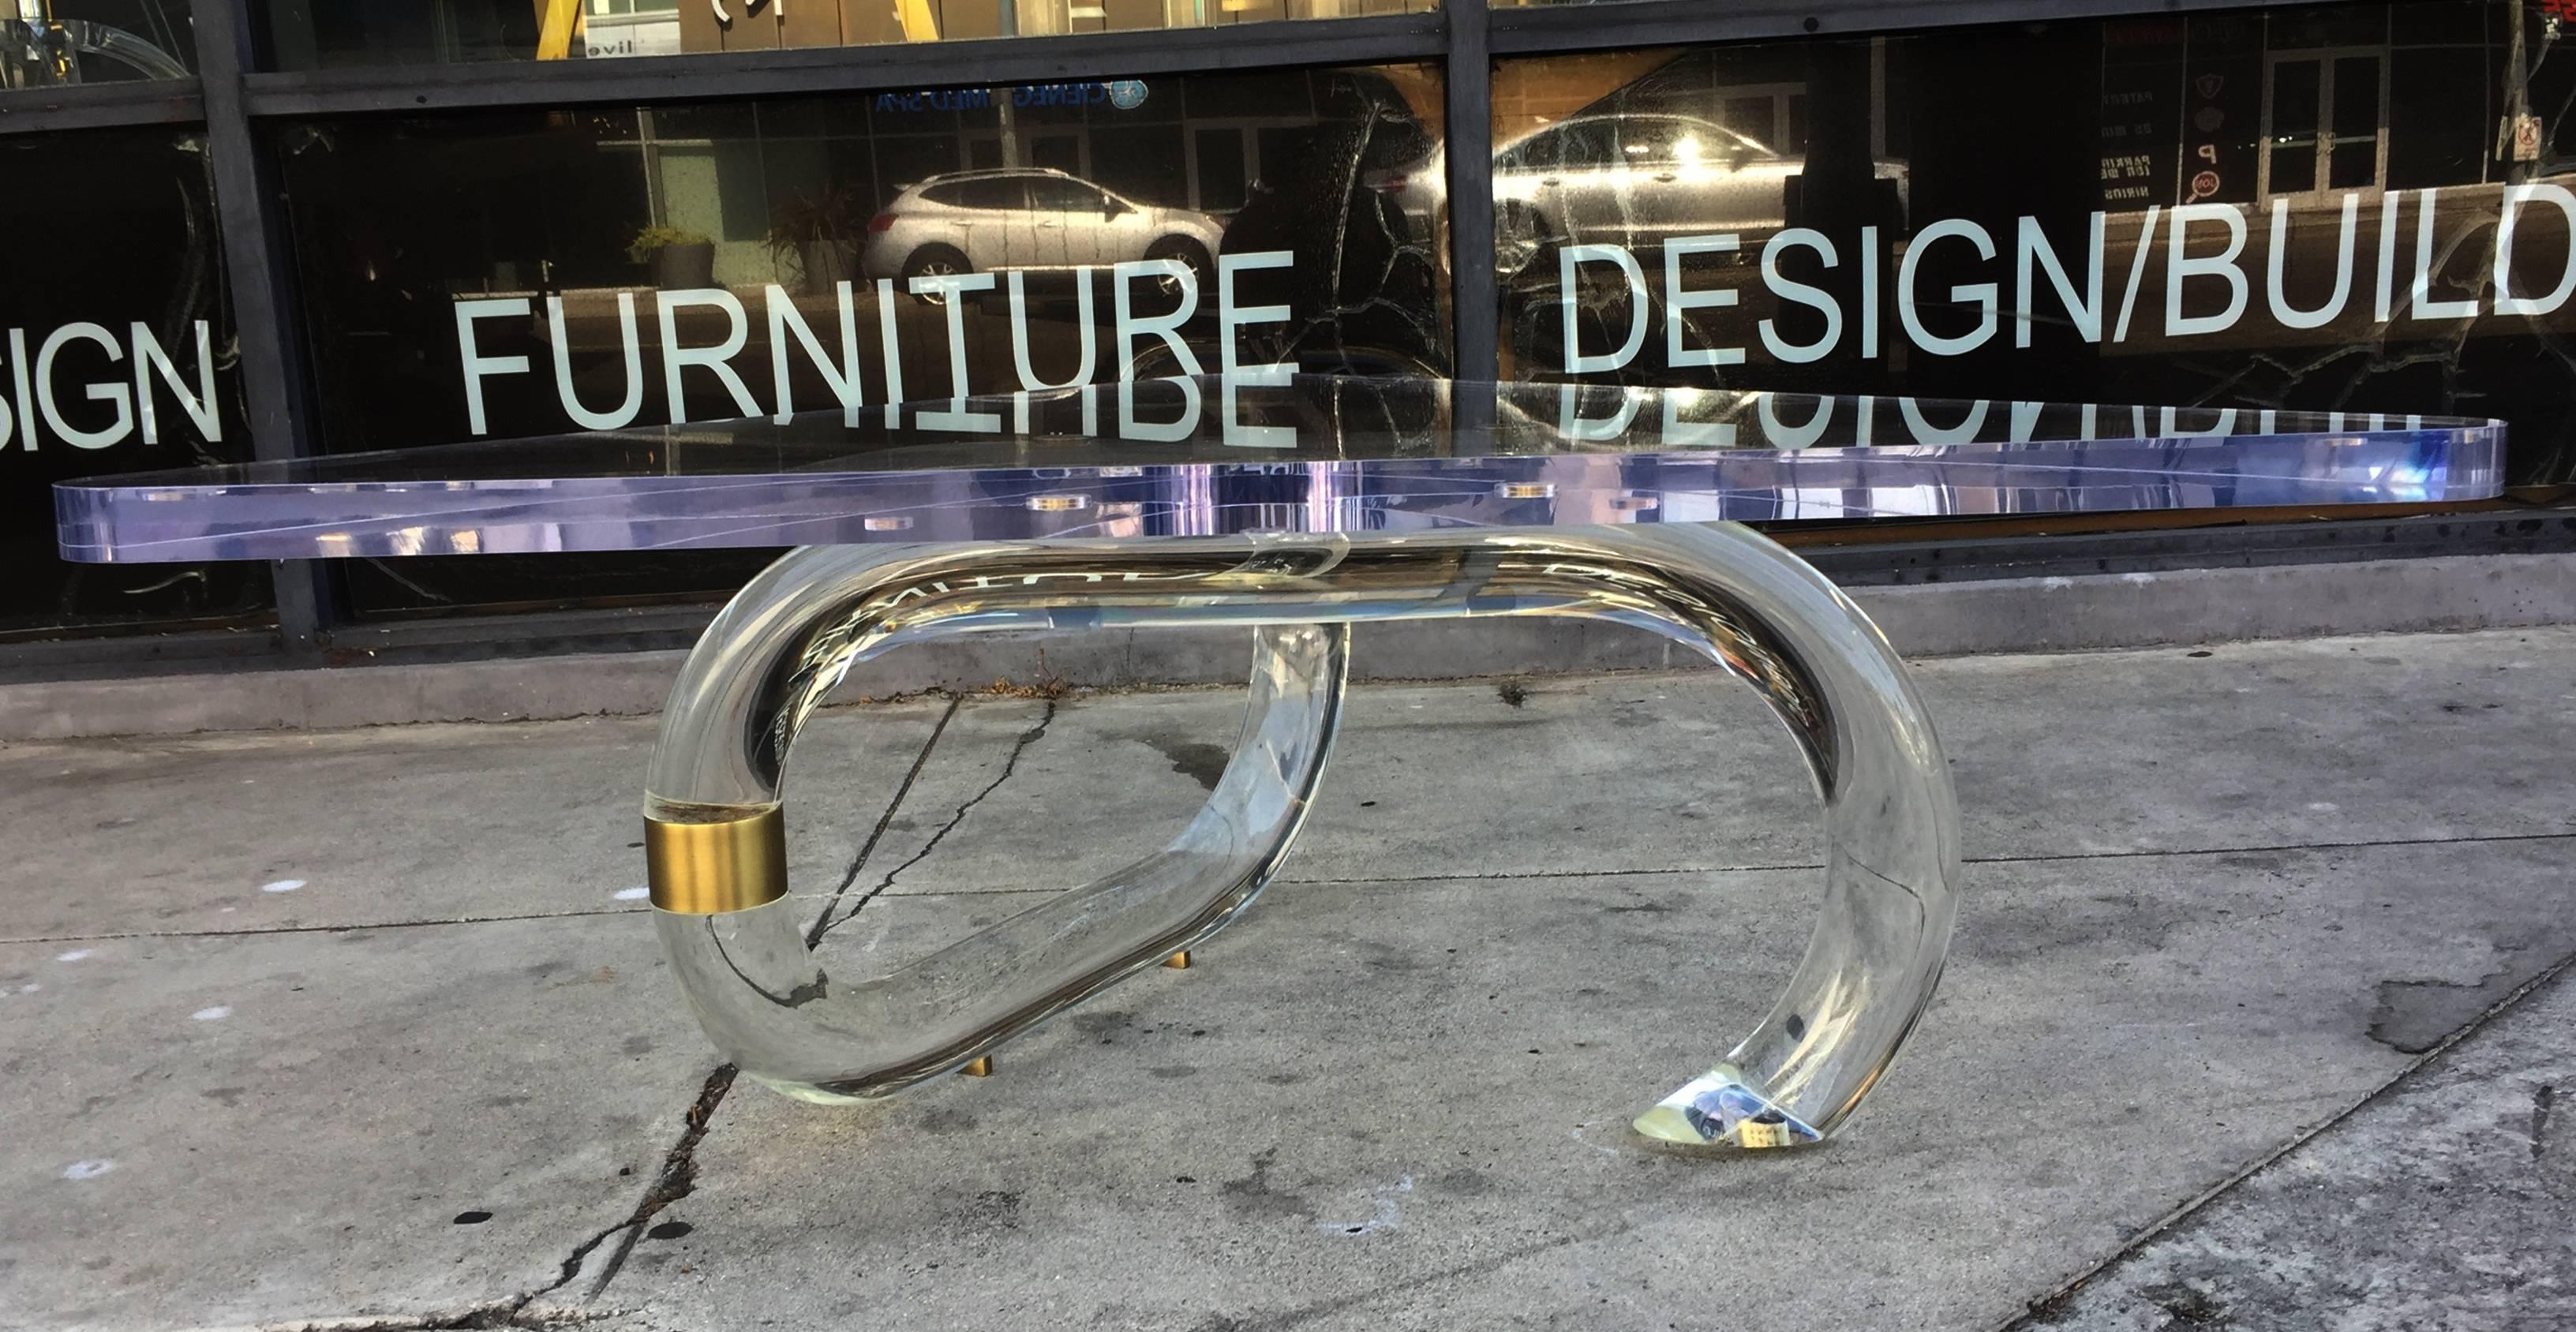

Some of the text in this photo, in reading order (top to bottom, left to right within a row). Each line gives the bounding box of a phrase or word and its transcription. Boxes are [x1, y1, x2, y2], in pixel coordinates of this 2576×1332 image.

[455, 250, 1300, 436] FURNITURE
[1559, 183, 2576, 374] DESIGN/BUILD
[0, 319, 223, 451] IGN
